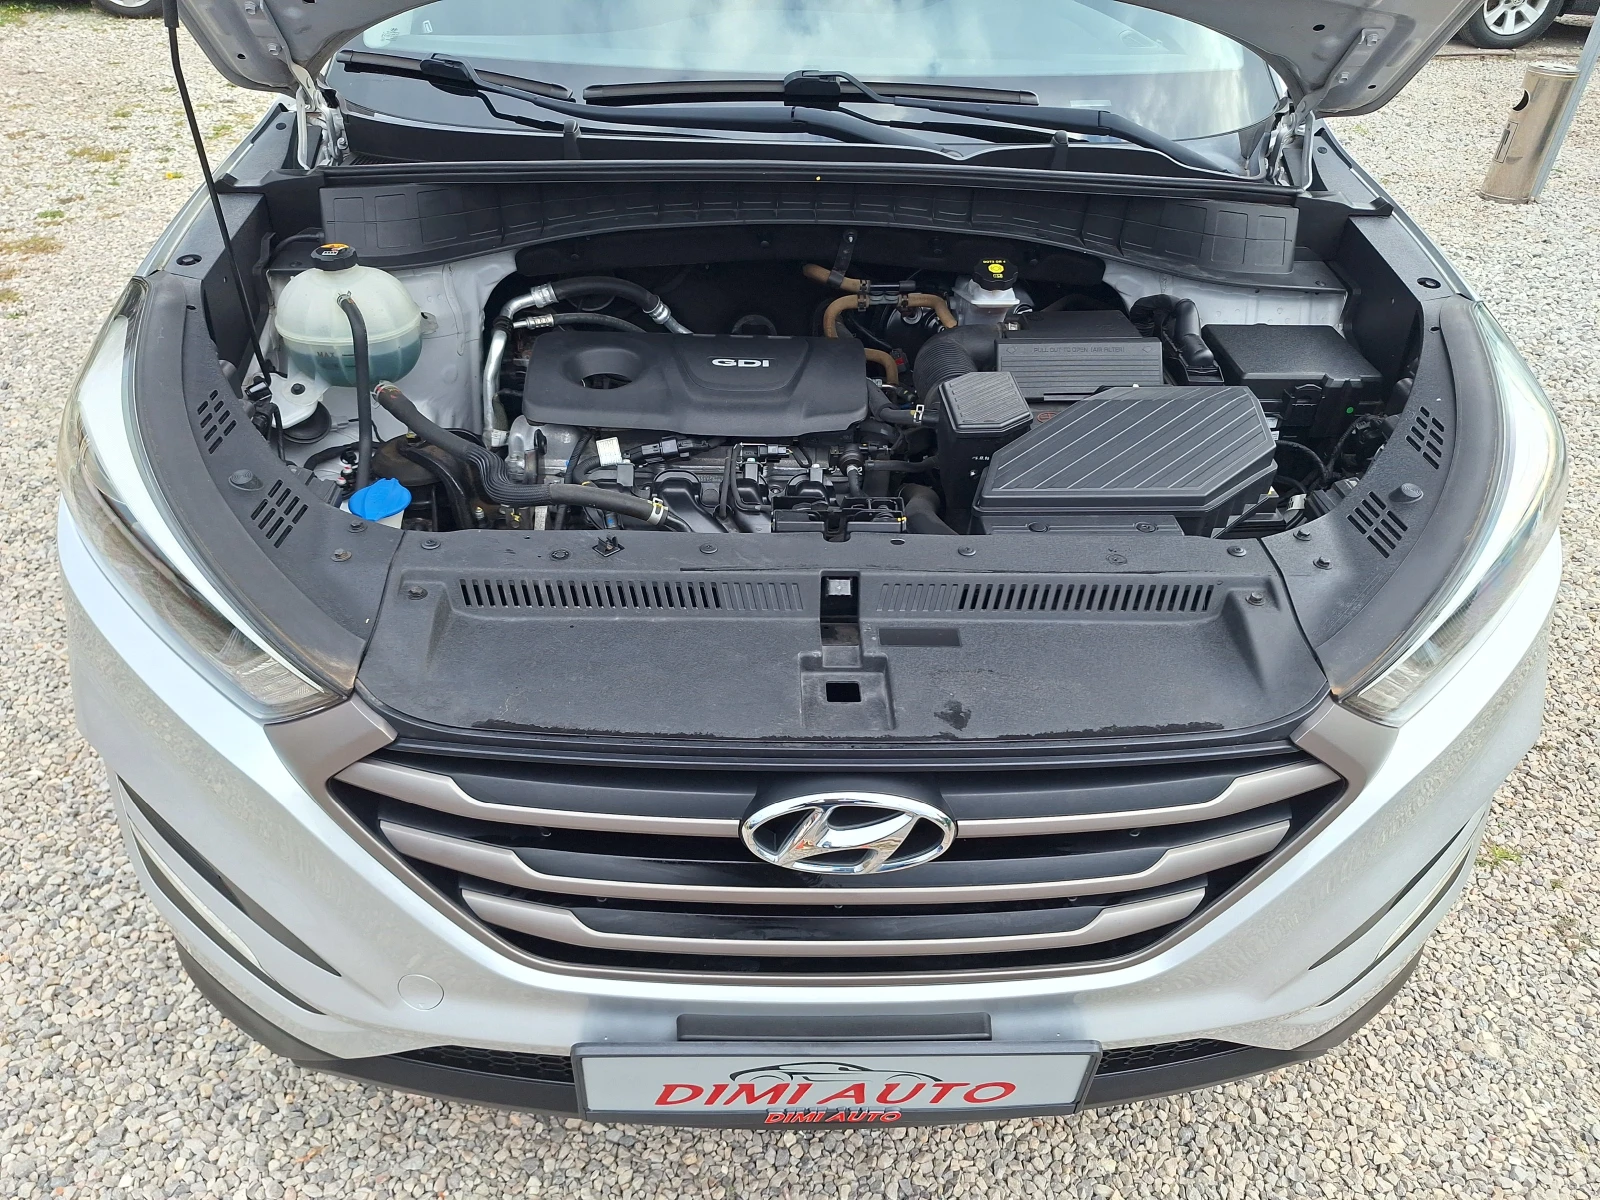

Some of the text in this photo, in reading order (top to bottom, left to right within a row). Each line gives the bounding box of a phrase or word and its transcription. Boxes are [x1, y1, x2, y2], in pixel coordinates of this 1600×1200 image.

[712, 358, 769, 367] GDI
[655, 1082, 1016, 1106] DIMI AUTO
[764, 1110, 902, 1124] DIMI AUTO
